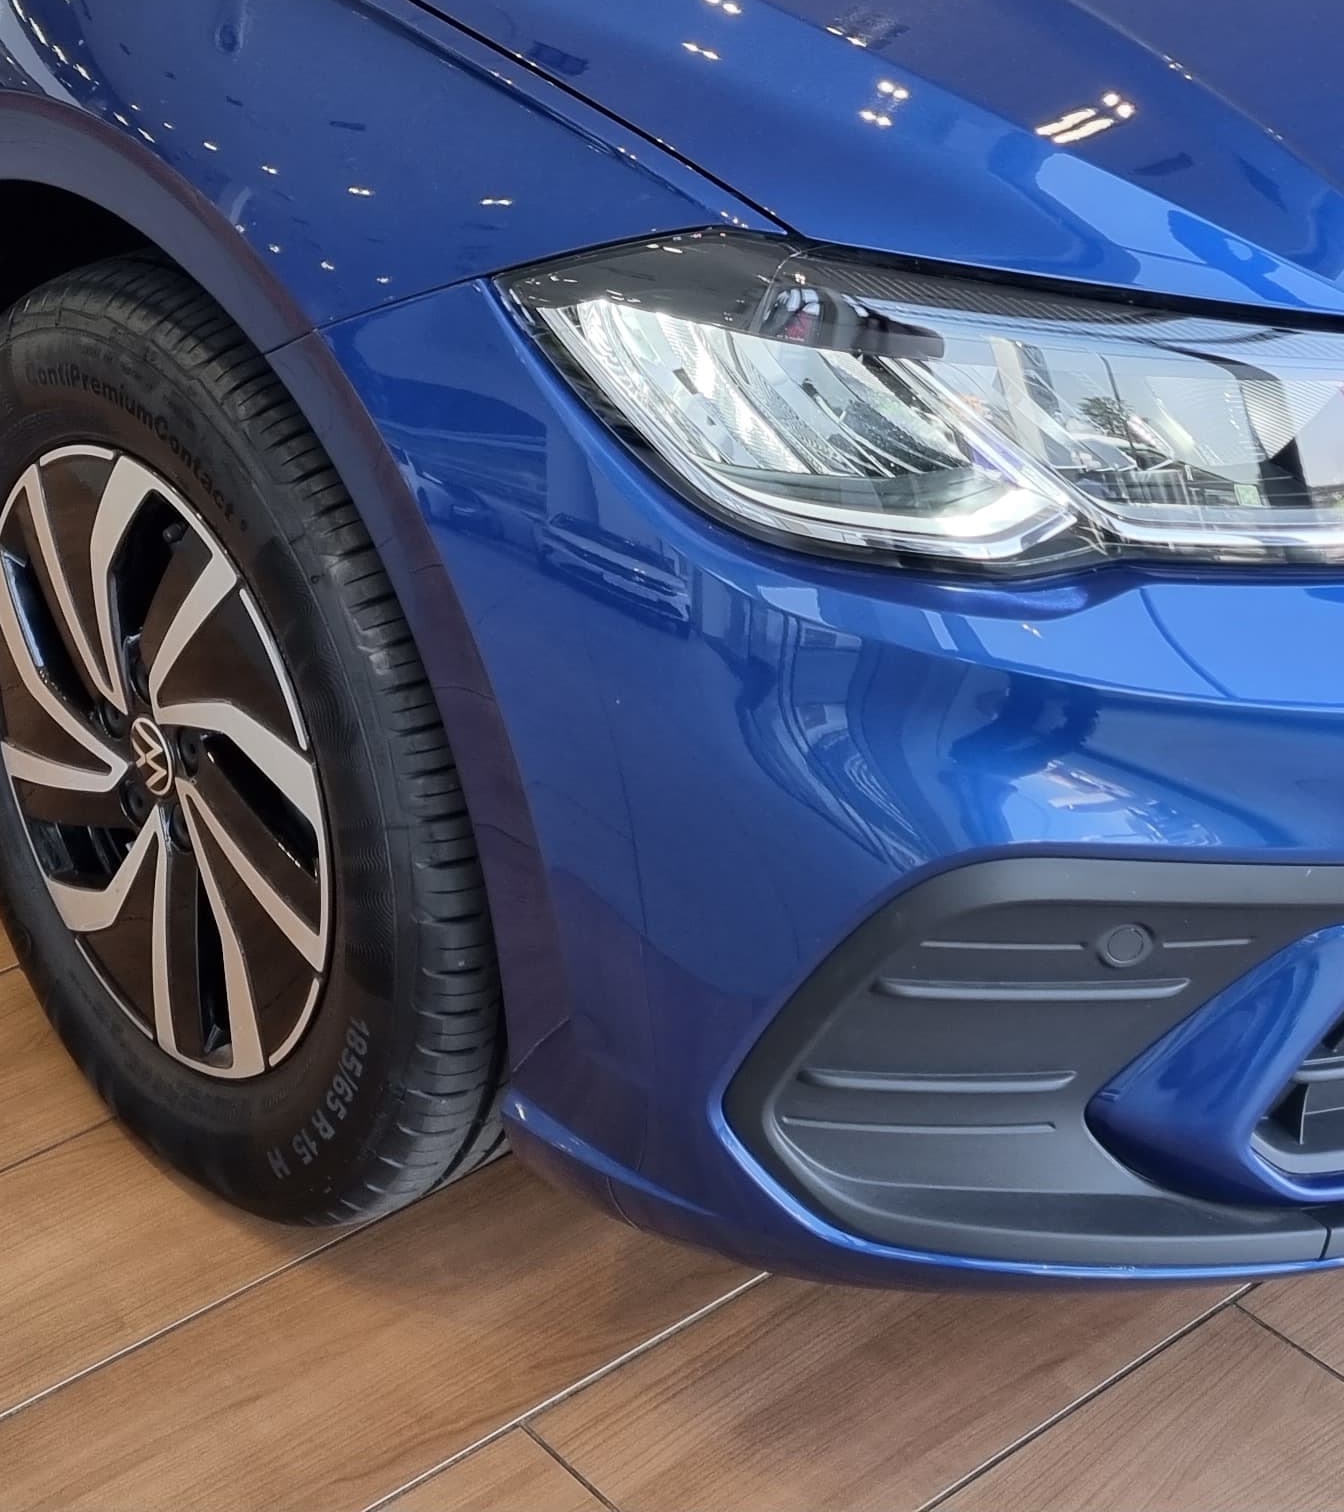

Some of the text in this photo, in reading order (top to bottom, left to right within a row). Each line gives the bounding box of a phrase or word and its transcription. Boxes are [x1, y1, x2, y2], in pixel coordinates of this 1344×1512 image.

[266, 1015, 371, 1180] 185/65 R 15 H
